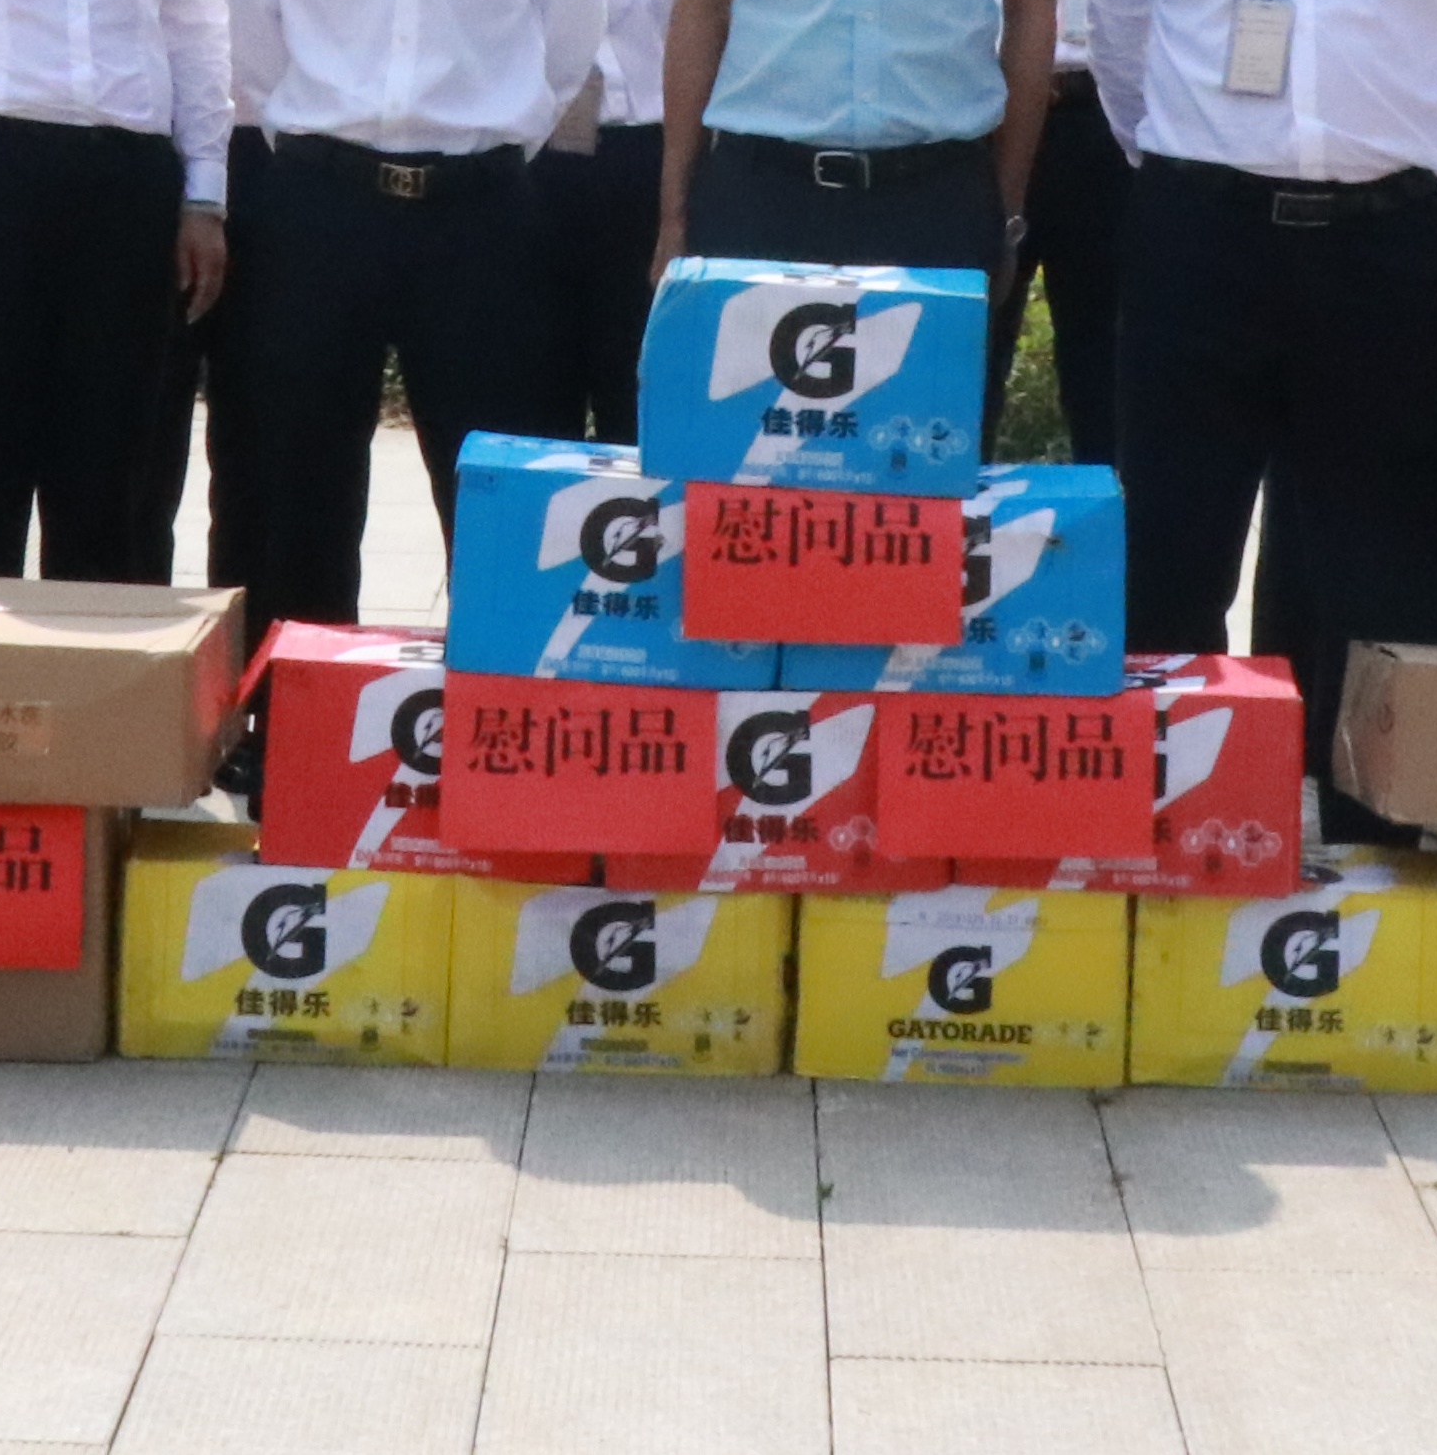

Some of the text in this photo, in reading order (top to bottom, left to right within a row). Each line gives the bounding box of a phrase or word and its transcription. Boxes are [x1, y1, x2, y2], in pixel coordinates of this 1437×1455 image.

[769, 302, 856, 399] G
[761, 407, 858, 438] 佳得乐
[712, 495, 933, 567] 慰问品
[571, 591, 660, 621] 佳得乐
[468, 705, 686, 777] 慰问品
[906, 711, 1124, 783] 慰问品
[385, 782, 441, 807] 佳得
[724, 814, 818, 843] 佳得乐
[234, 987, 330, 1018] 佳得乐
[565, 1000, 661, 1027] 佳得乐
[888, 1018, 1032, 1045] GATORADE
[1255, 1007, 1344, 1034] 佳得乐
